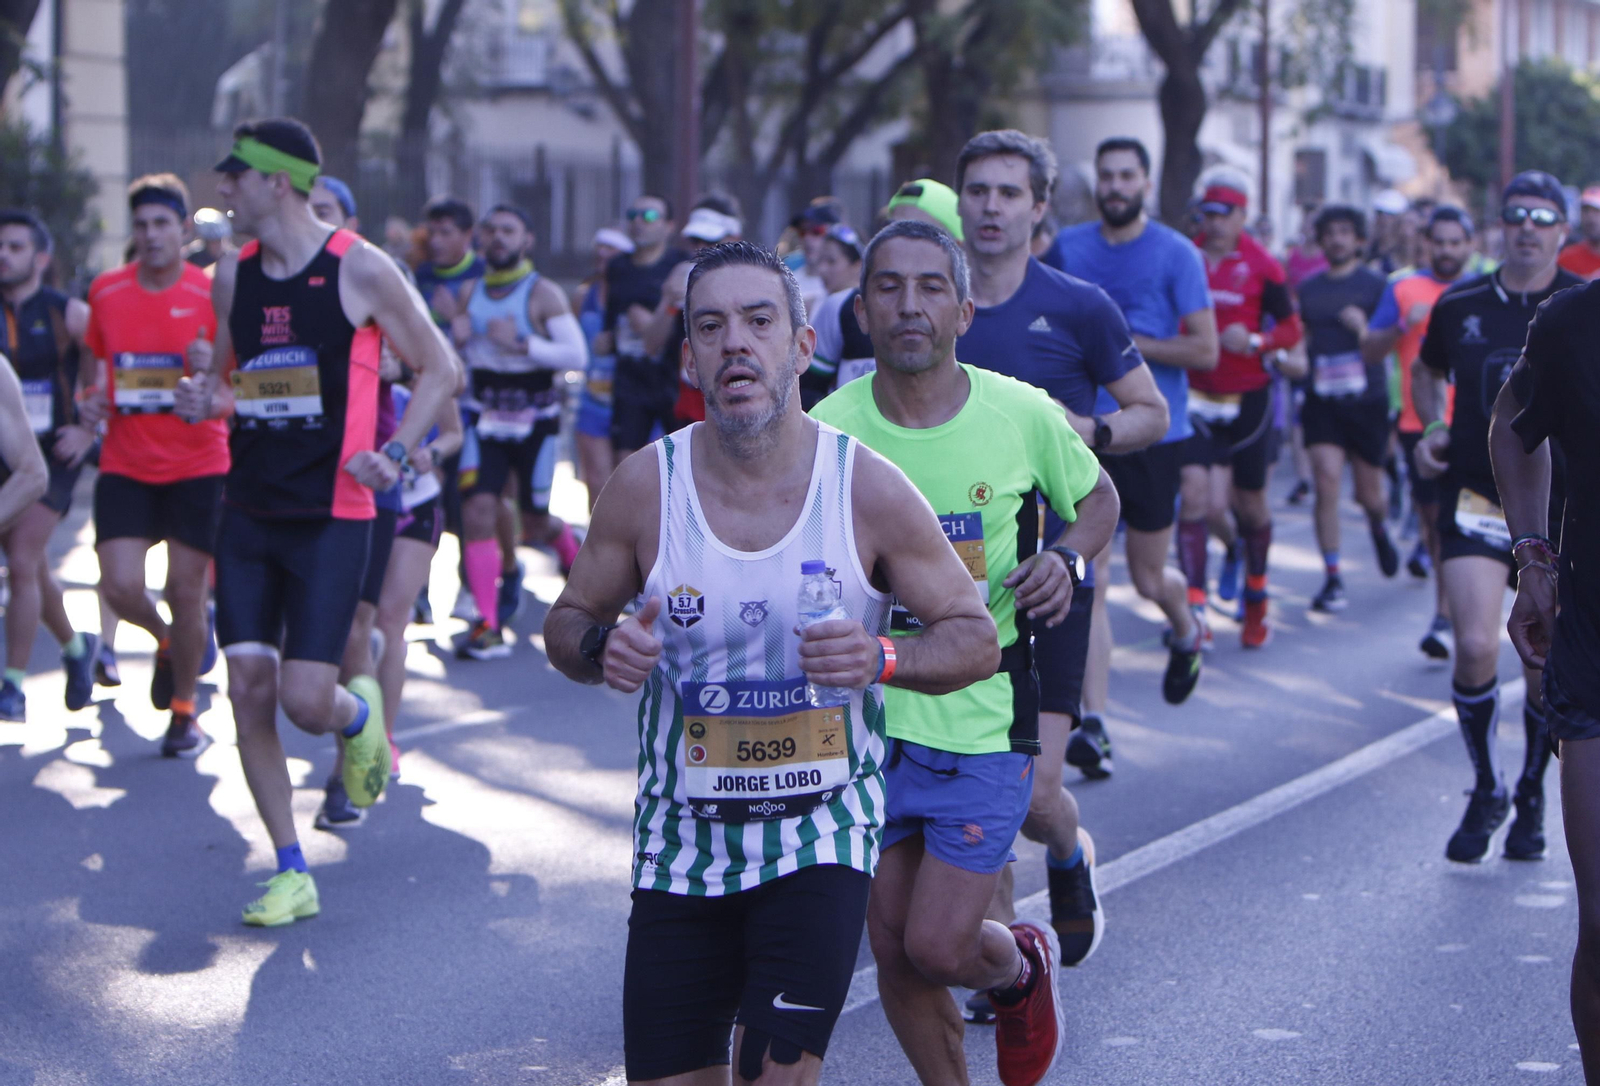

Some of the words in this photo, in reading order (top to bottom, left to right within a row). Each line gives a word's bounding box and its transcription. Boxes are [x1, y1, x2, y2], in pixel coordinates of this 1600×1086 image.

[262, 306, 291, 324] YES
[256, 351, 305, 366] ZURICH
[258, 382, 291, 396] 5321
[678, 597, 692, 608] 5.7
[736, 737, 796, 762] 5639
[712, 776, 770, 792] JORGE
[775, 769, 822, 790] LOBO
